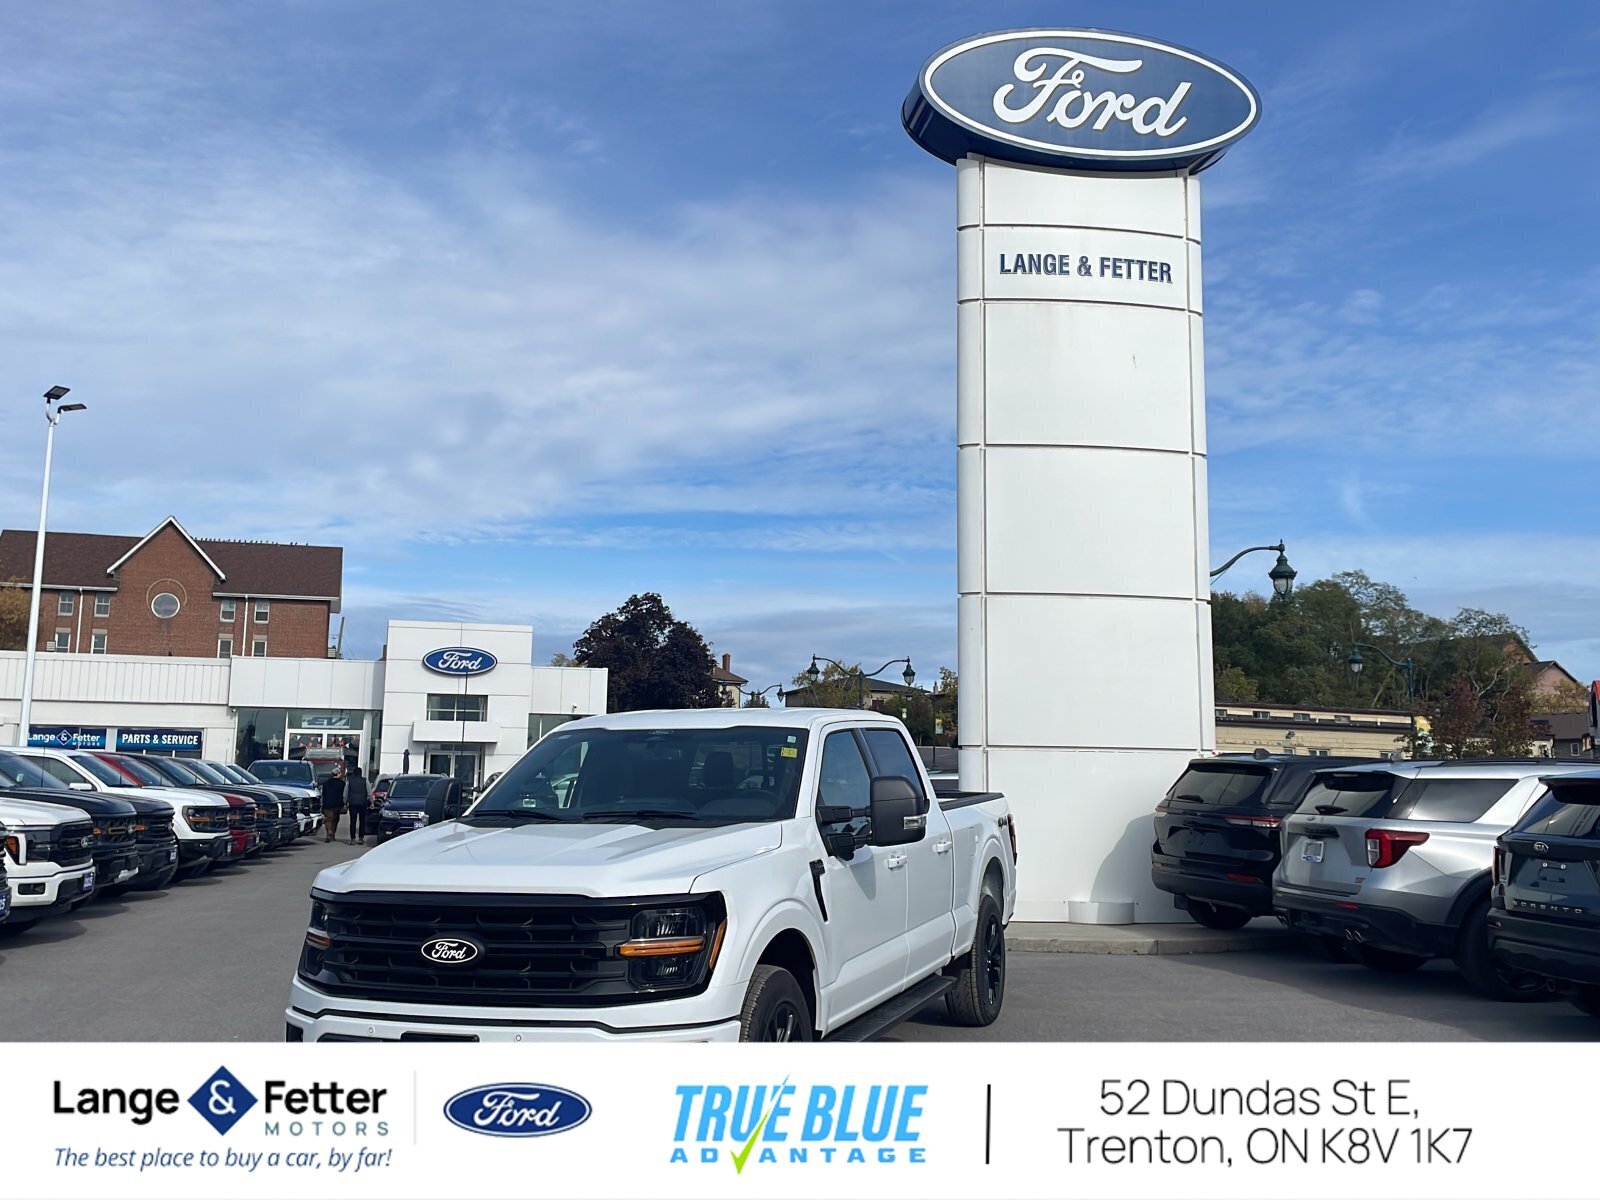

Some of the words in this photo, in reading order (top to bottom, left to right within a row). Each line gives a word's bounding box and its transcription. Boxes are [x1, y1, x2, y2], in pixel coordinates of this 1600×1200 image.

[993, 47, 1192, 136] Ford
[1000, 253, 1070, 276] LANGE
[1077, 255, 1093, 277] &
[1099, 256, 1173, 284] FETTER
[438, 651, 483, 670] Ford
[28, 732, 56, 743] Lange
[60, 732, 68, 742] &
[72, 733, 101, 742] Fetter
[122, 733, 151, 745] PARTS
[152, 734, 159, 744] &
[161, 734, 199, 745] SERVICE
[432, 942, 467, 959] Ford
